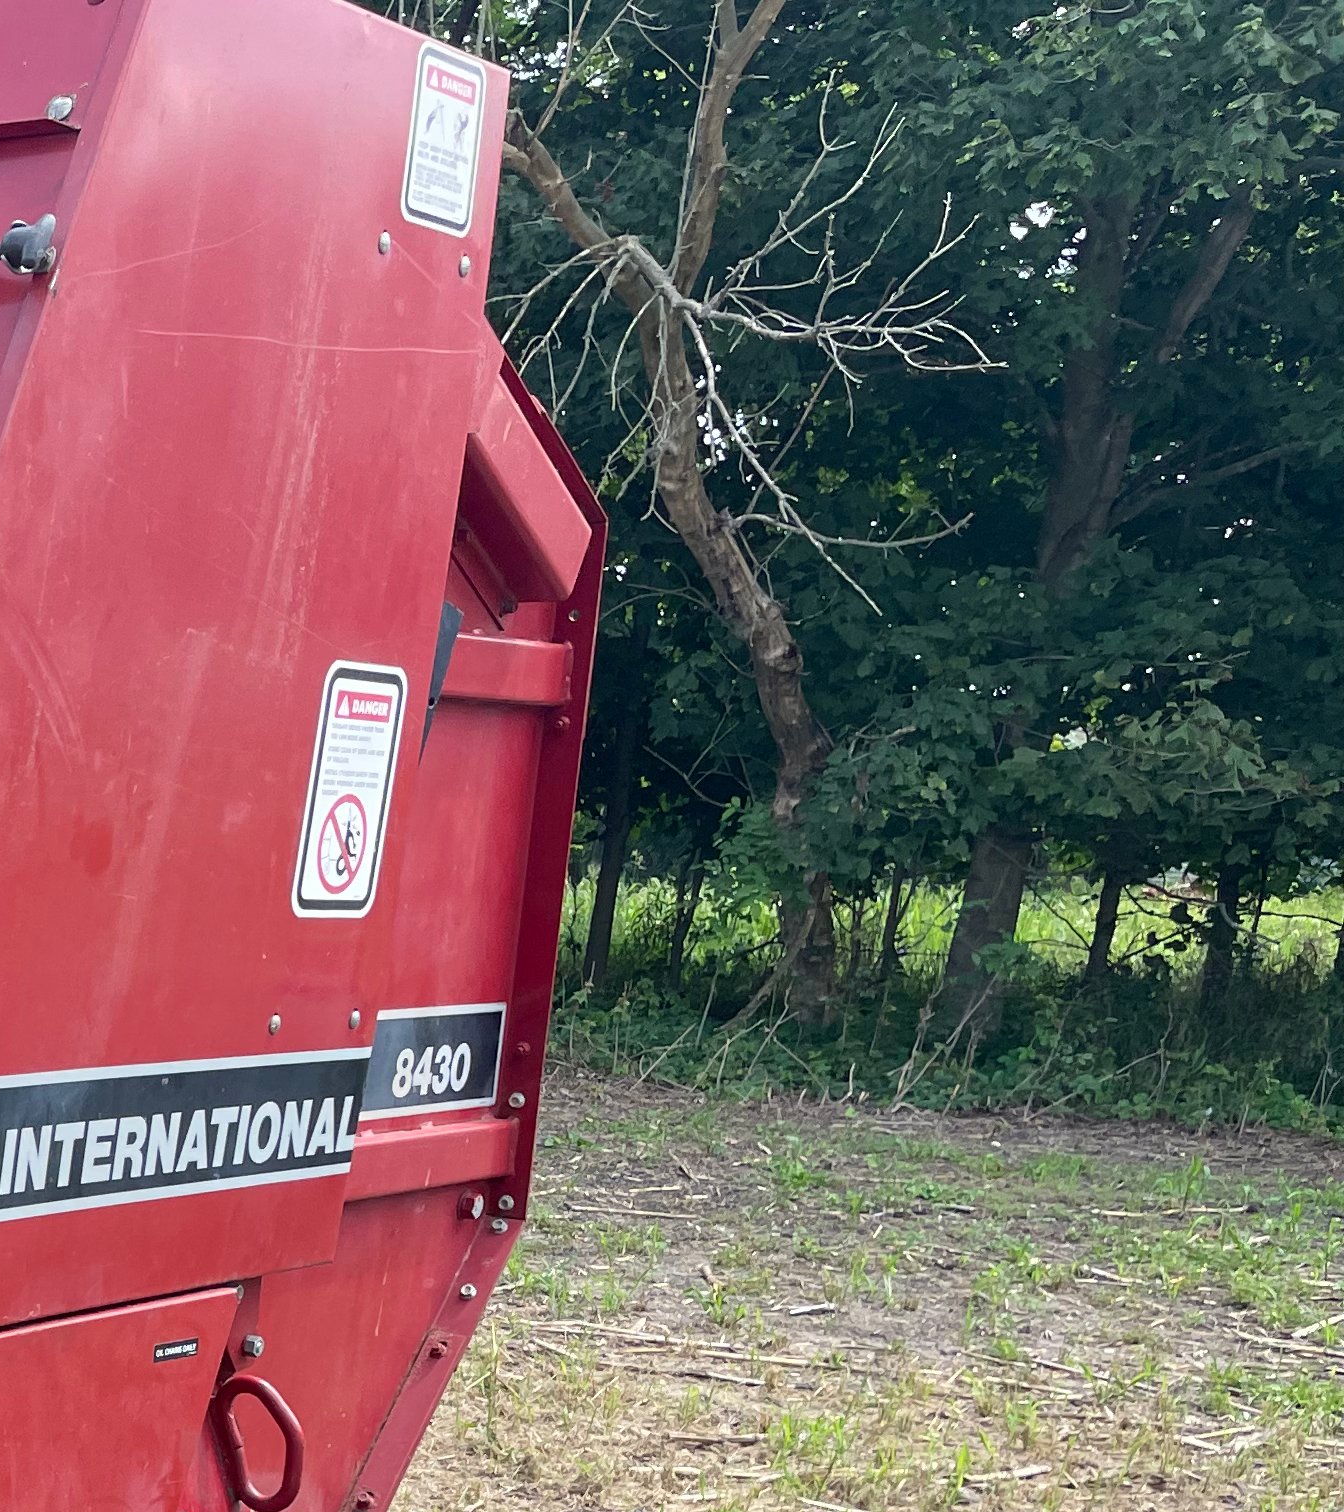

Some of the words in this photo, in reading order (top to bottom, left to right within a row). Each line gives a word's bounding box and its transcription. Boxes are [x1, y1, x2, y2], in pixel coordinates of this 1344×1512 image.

[442, 76, 473, 99] DANGER
[352, 699, 388, 717] DANGER
[392, 1042, 472, 1099] 8430
